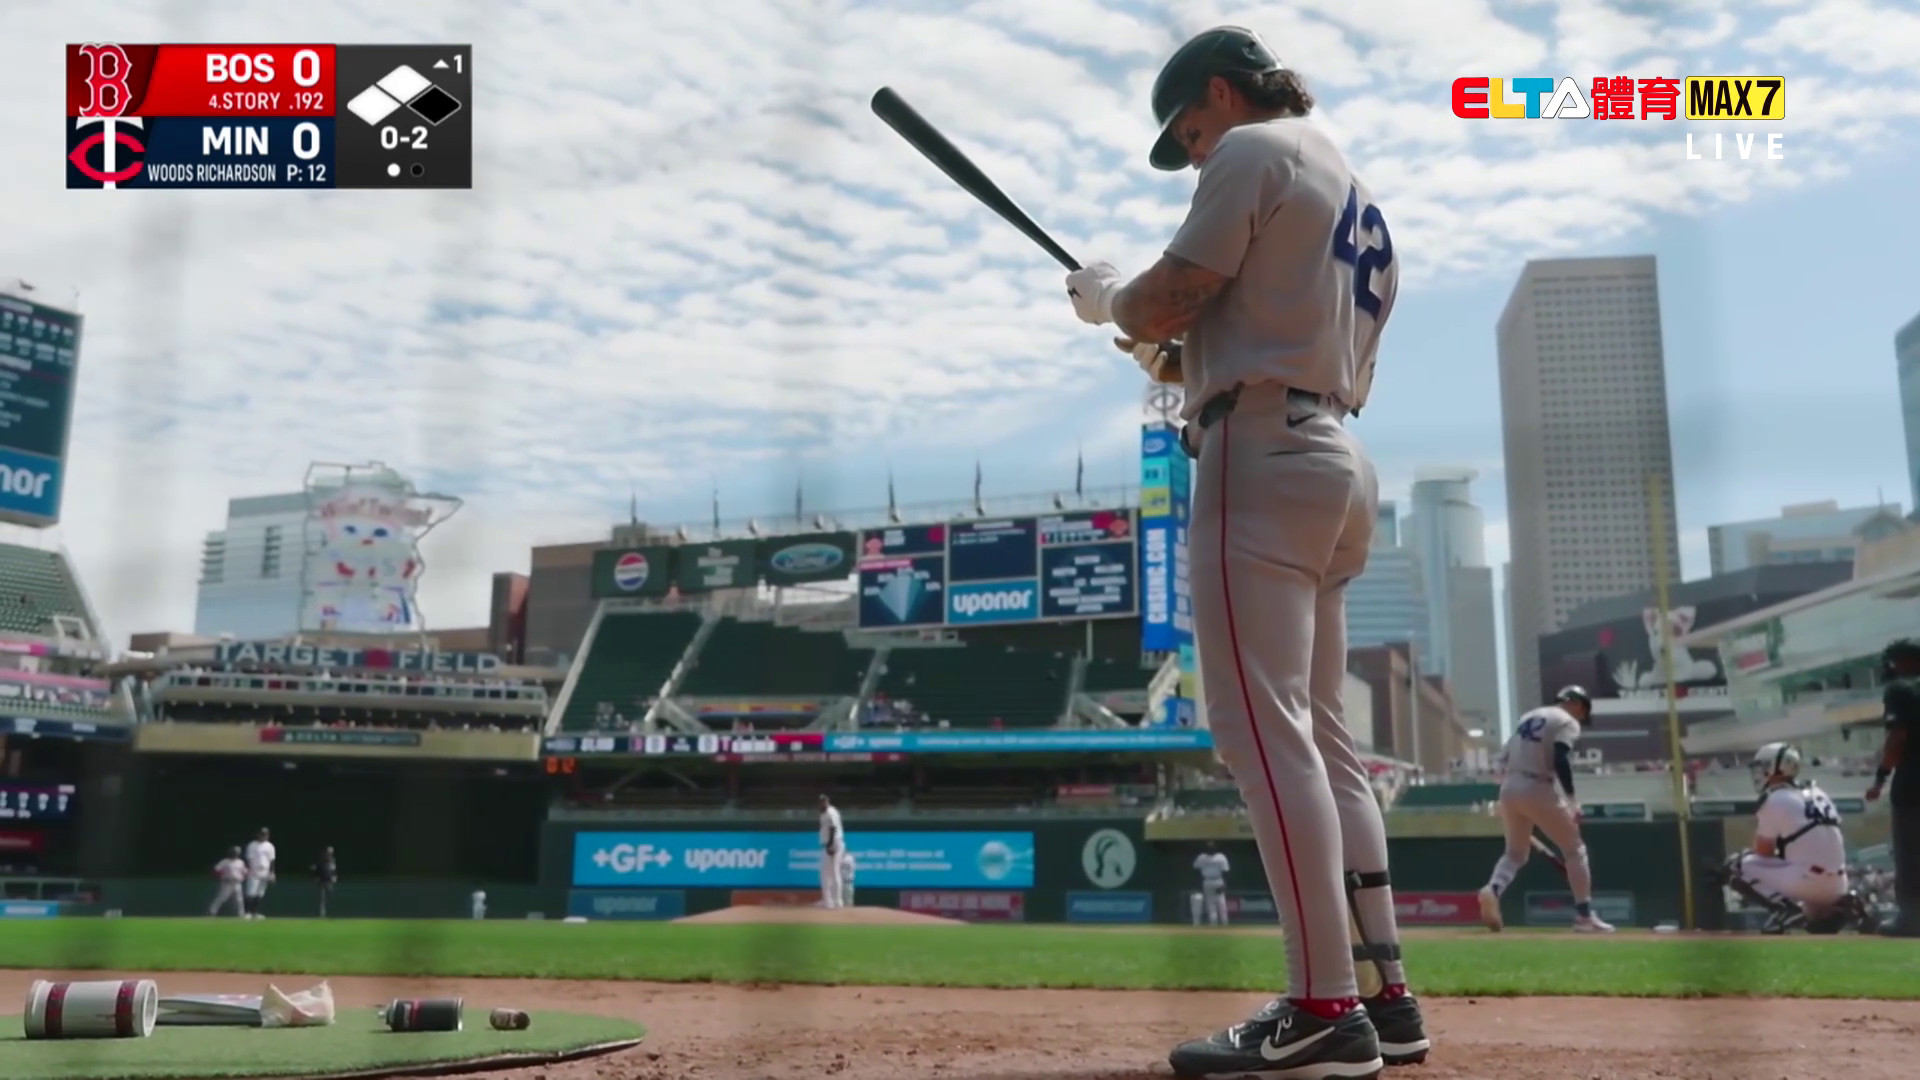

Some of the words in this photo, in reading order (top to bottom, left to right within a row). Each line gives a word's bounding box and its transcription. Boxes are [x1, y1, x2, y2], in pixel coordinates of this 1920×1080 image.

[1333, 184, 1393, 322] 42
[953, 588, 1033, 617] uponor
[218, 643, 356, 669] TARGET
[399, 651, 501, 674] FIELD
[1517, 716, 1547, 742] 42
[684, 848, 769, 873] uponor
